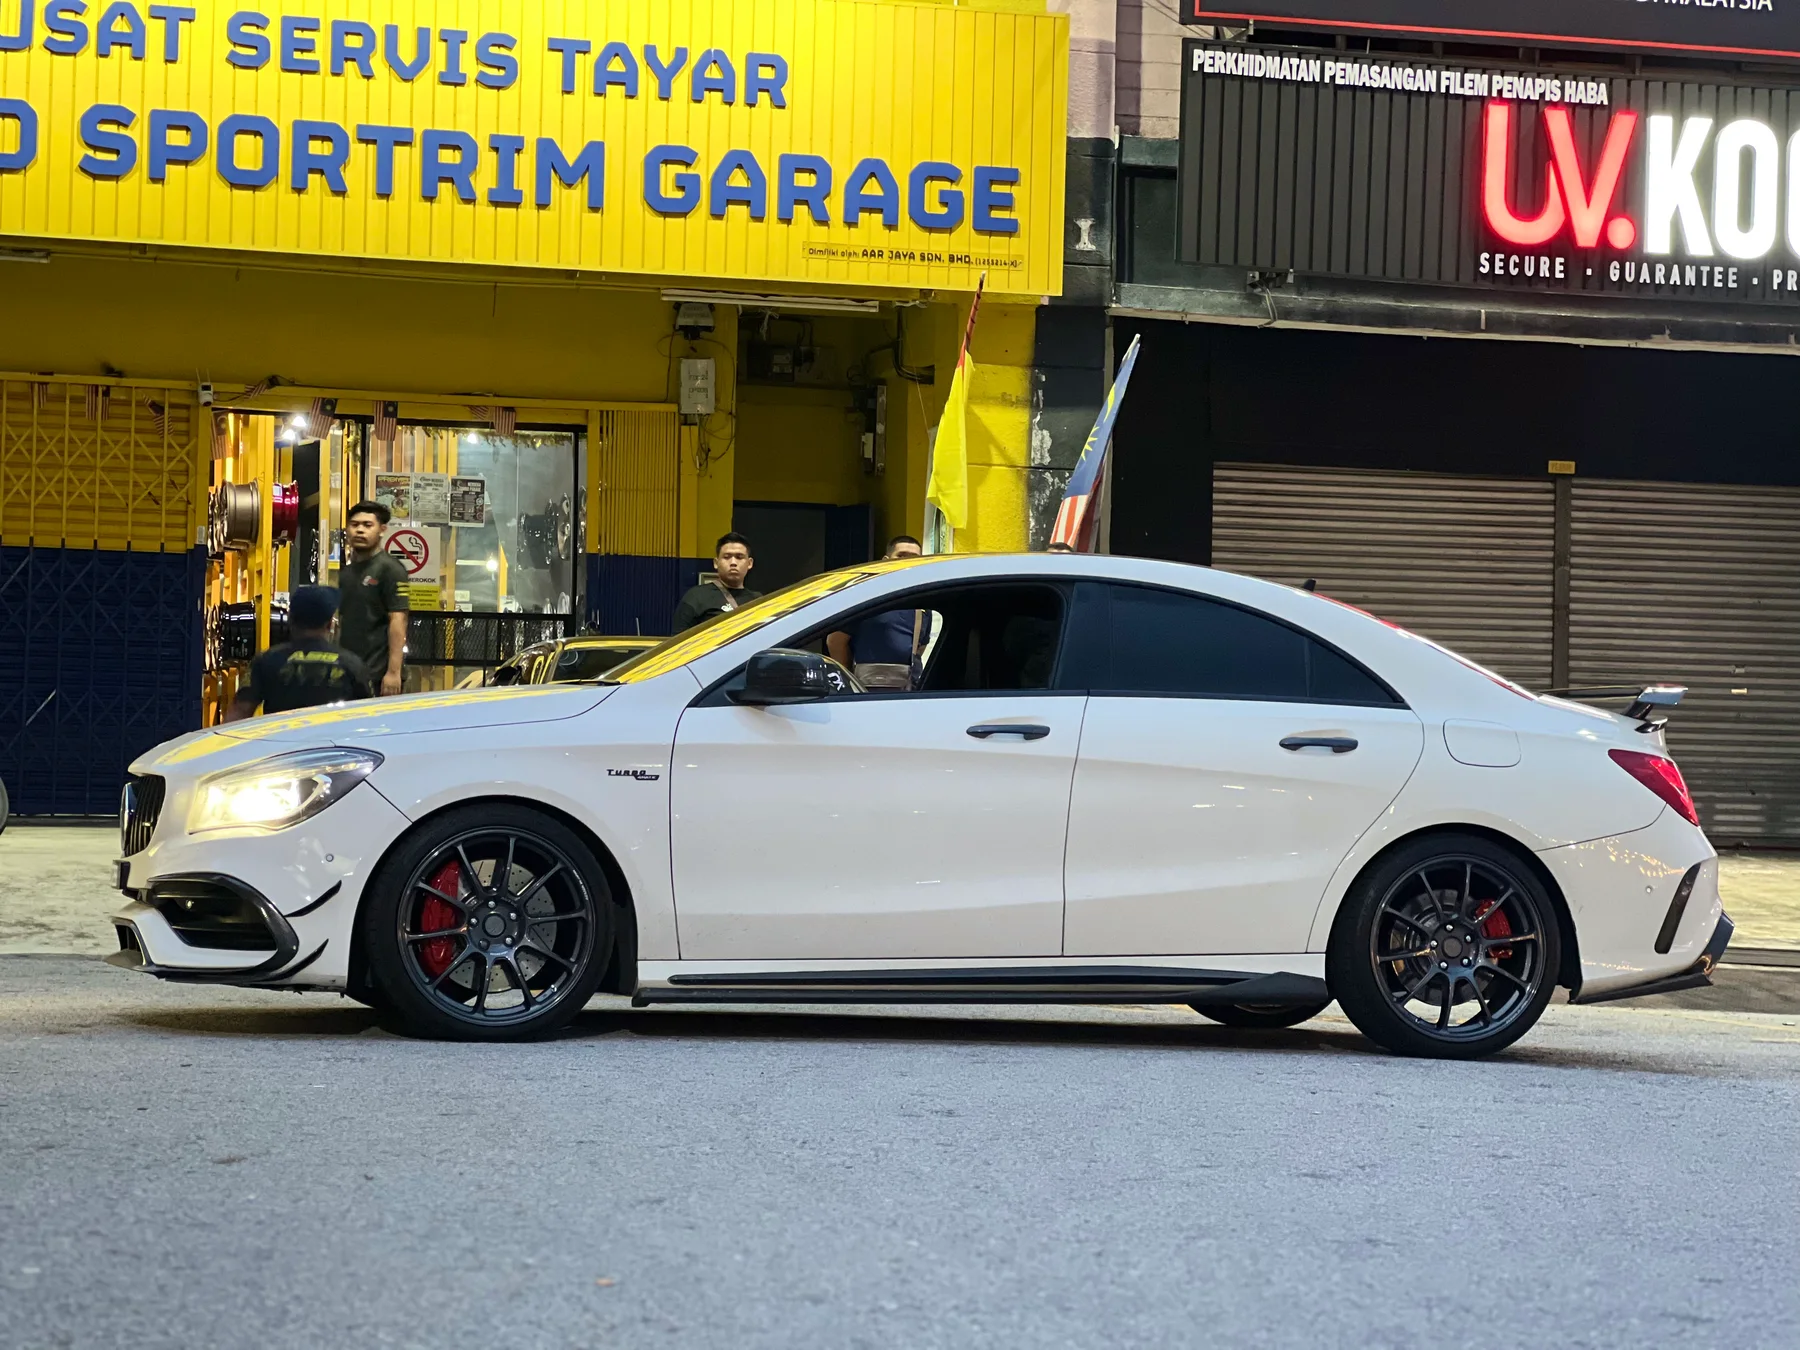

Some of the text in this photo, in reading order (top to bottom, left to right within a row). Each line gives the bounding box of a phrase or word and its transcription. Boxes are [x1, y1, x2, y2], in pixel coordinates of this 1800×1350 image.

[227, 11, 518, 89] SERVIS
[548, 37, 787, 107] TAYAR
[1193, 48, 1609, 106] PERKHIDMATAN PEMASANGAN FILEM PENAPIS HABA
[78, 103, 604, 209] SPORTRIM
[643, 144, 1020, 232] GARAGE
[861, 248, 884, 260] AAR
[888, 250, 916, 261] JAYA
[919, 252, 945, 263] SDN.
[1479, 252, 1798, 291] SECURE GUARANTEE PR
